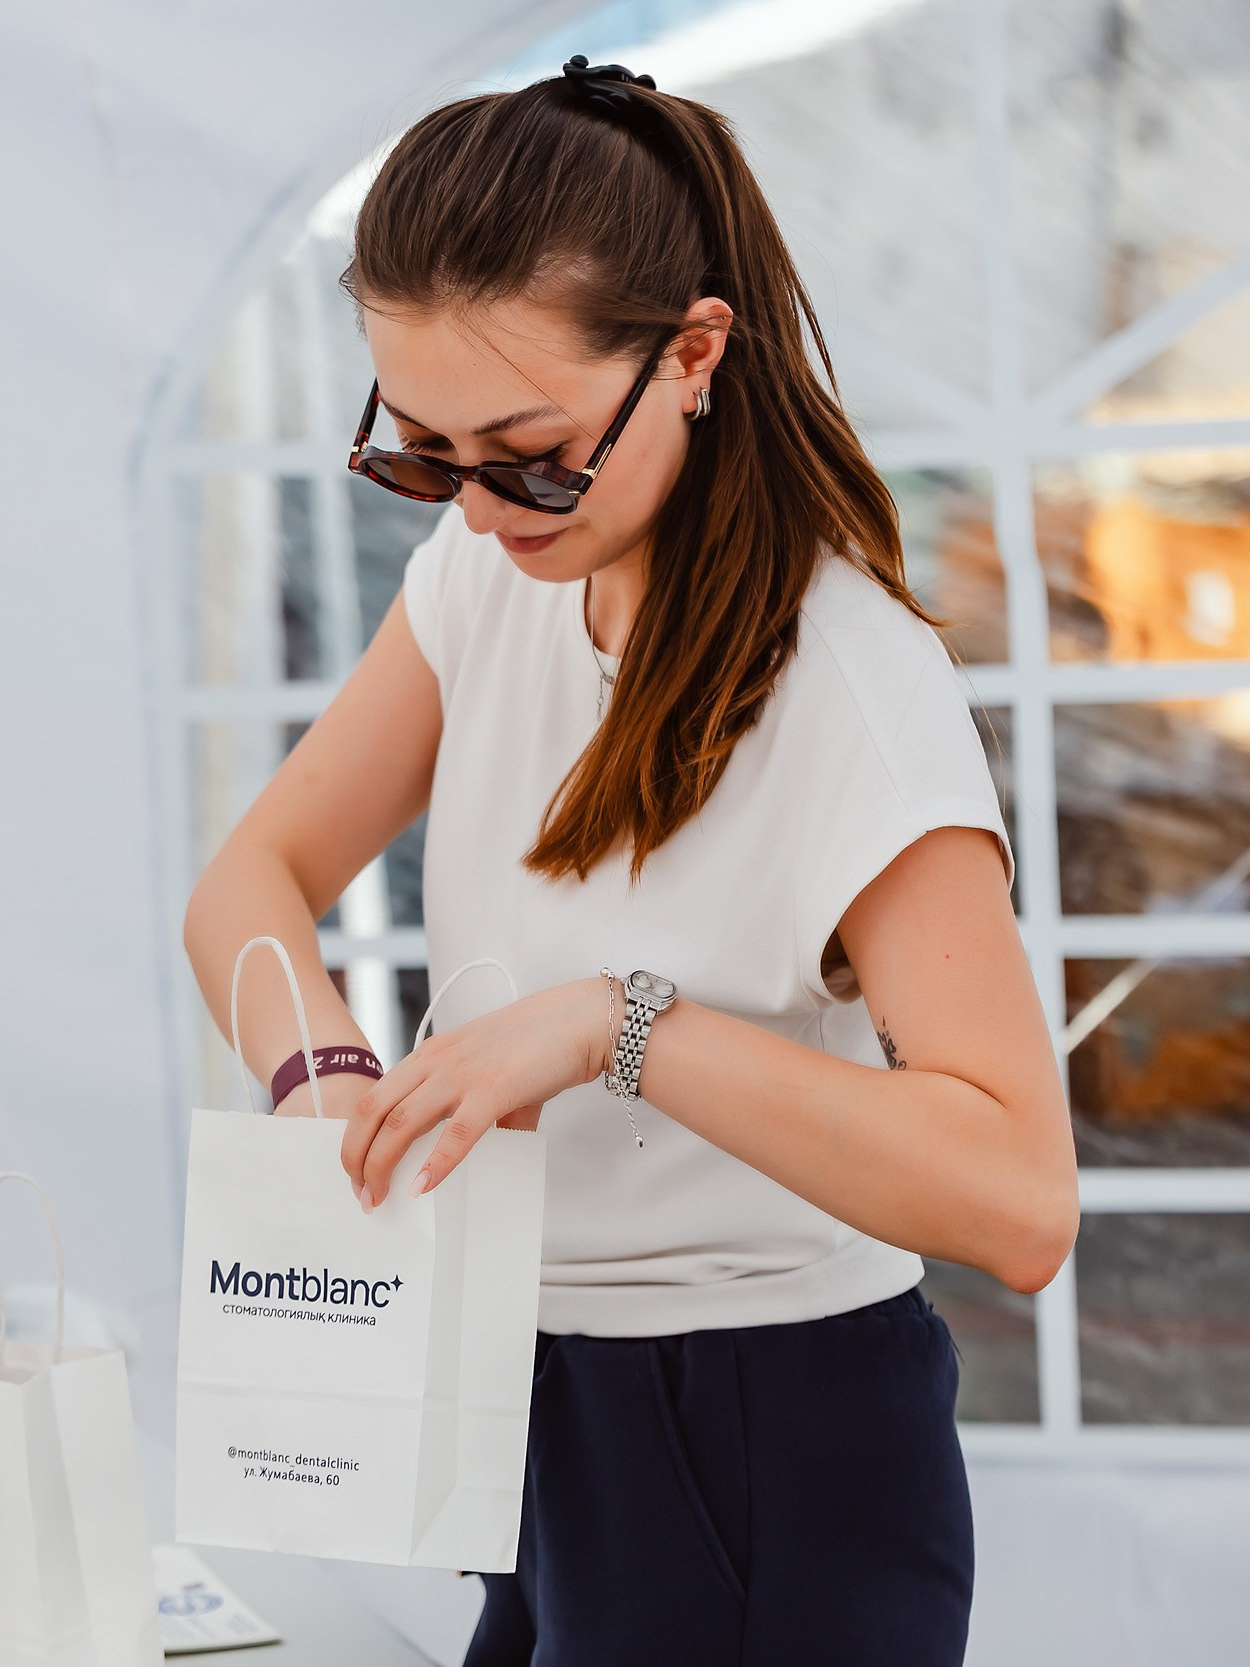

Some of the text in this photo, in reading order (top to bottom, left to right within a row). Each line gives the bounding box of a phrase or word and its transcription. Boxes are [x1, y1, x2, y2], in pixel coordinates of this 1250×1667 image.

[330, 1053, 359, 1066] air
[210, 1260, 391, 1308] Montblanc
[223, 1304, 376, 1326] стоматологиялық клиника
[227, 1446, 360, 1471] @montblanc_dentalclinic
[244, 1466, 340, 1486] ул. Жумабаева, 60
